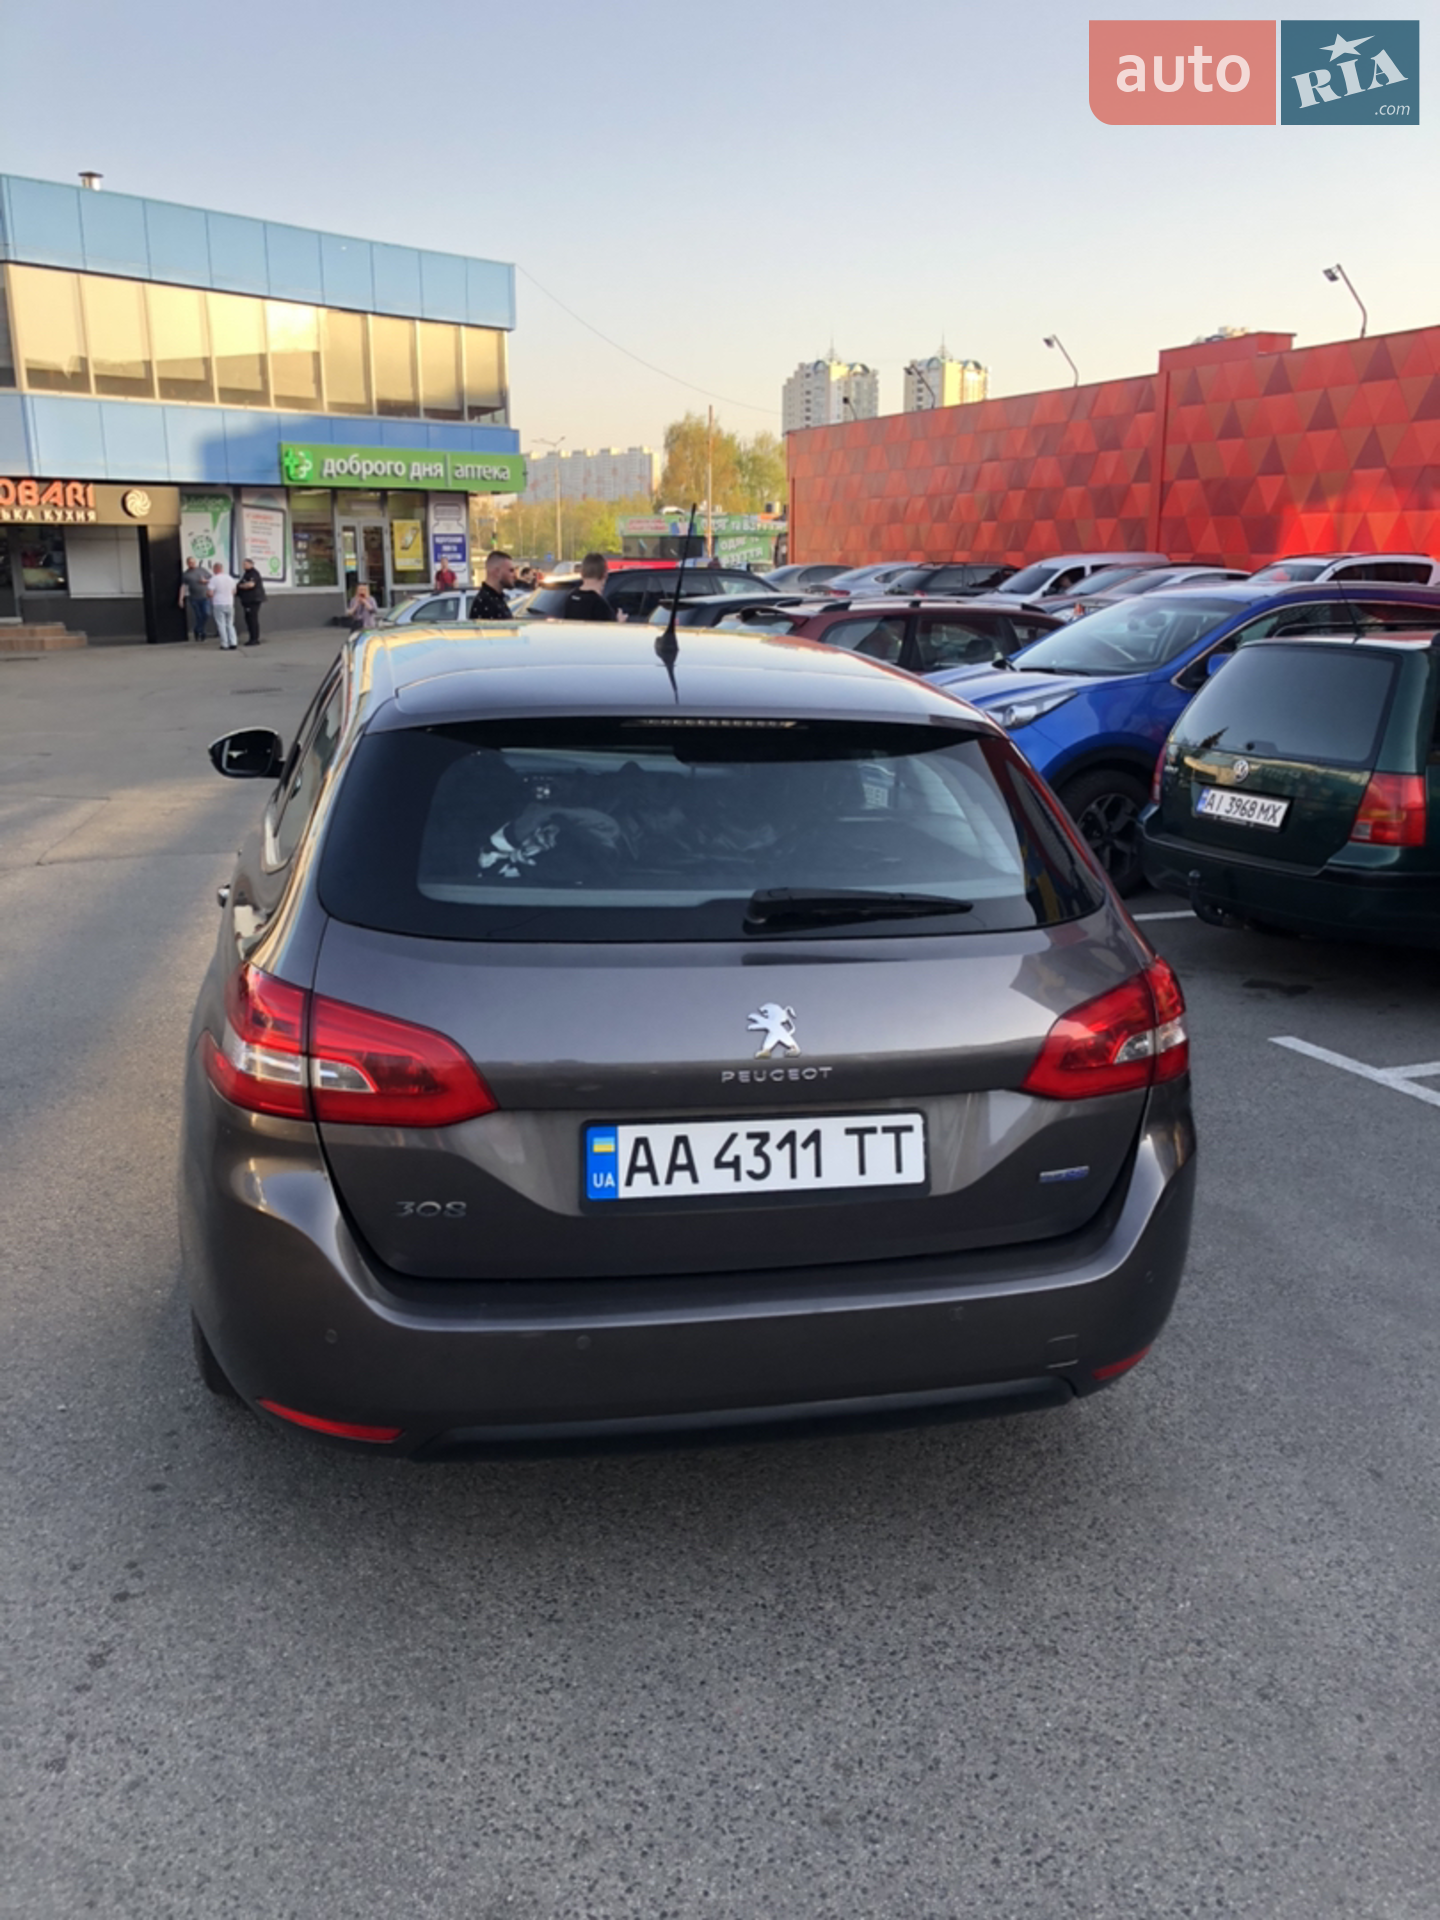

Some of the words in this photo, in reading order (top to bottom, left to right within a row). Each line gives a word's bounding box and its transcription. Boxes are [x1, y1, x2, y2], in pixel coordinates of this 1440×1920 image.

[323, 453, 406, 481] доброго
[409, 461, 444, 481] дня
[454, 463, 511, 481] аптека
[43, 509, 96, 522] КУХНЯ
[1205, 793, 1224, 811] AI
[1225, 796, 1258, 818] 3968
[1257, 803, 1282, 823] MX
[721, 1066, 833, 1083] PEUGEOT
[624, 1133, 700, 1187] AA
[714, 1128, 822, 1182] 4311
[844, 1125, 914, 1176] TT
[592, 1172, 616, 1188] UA
[396, 1201, 468, 1218] 308
